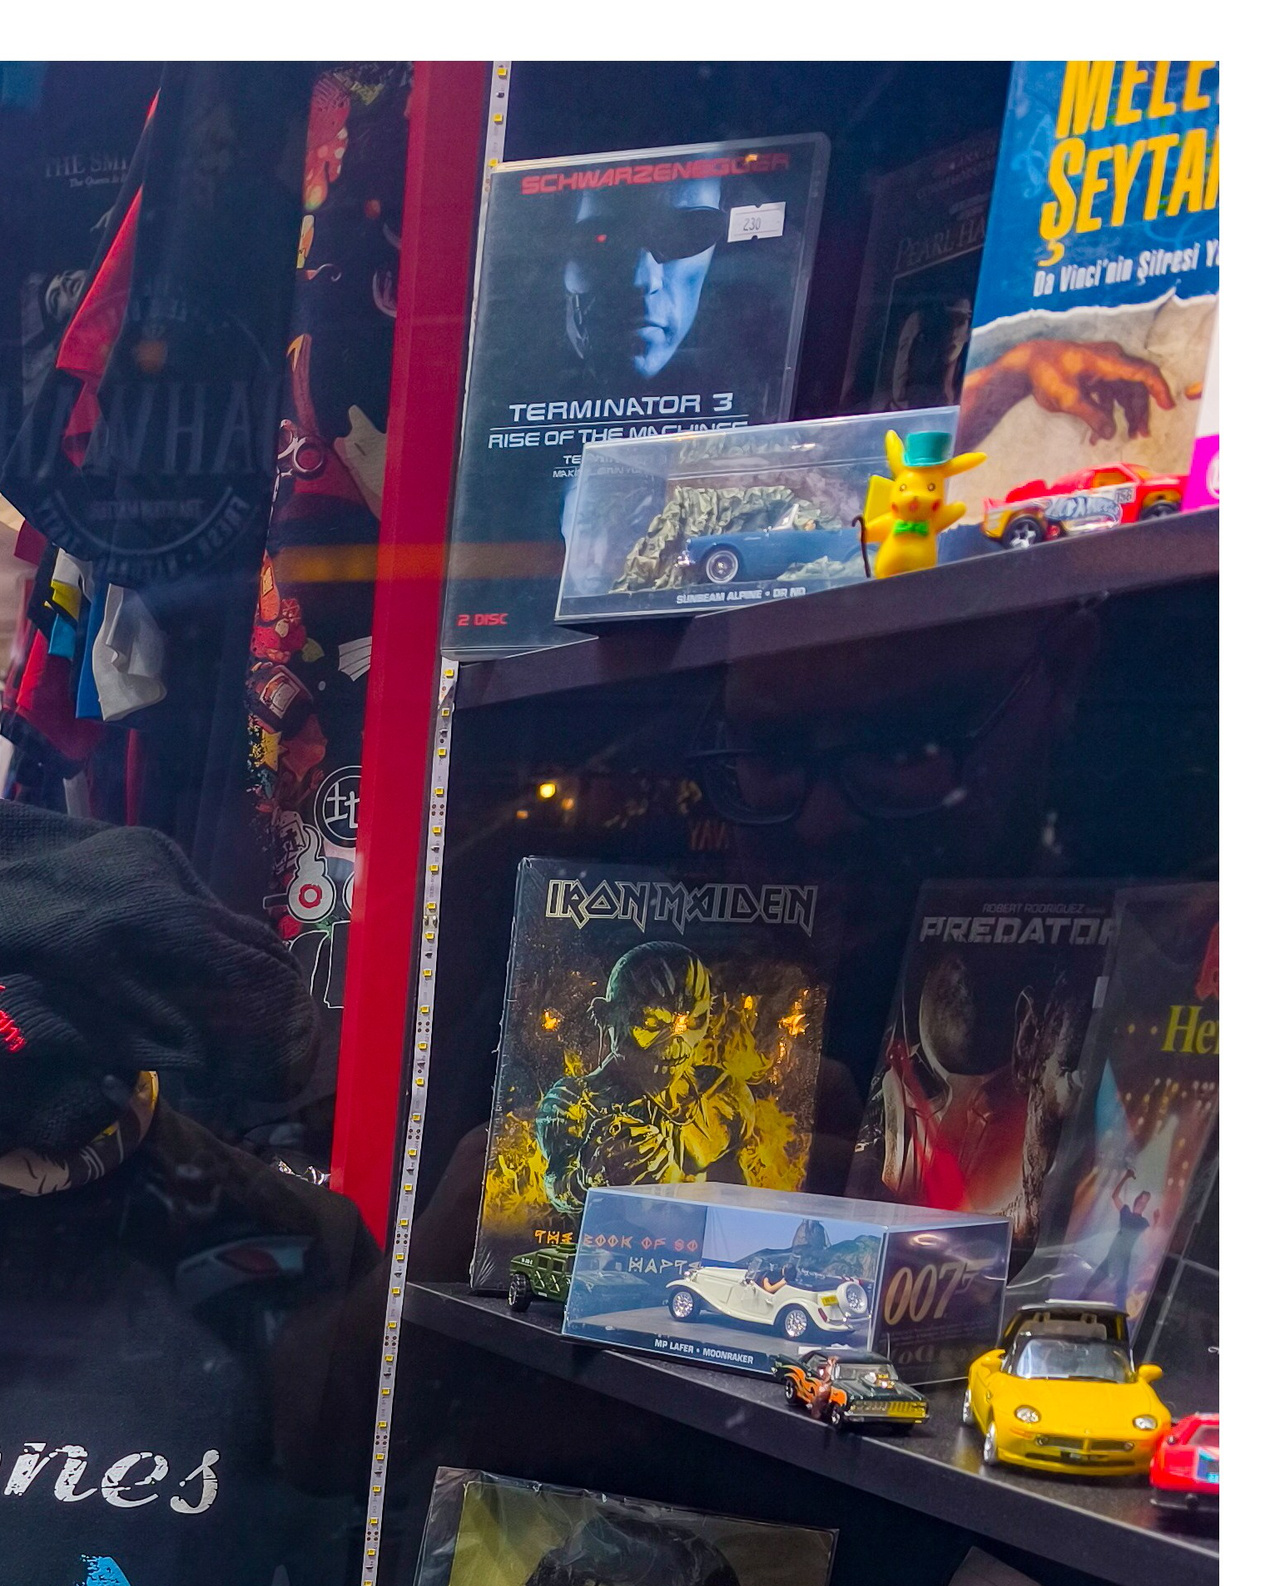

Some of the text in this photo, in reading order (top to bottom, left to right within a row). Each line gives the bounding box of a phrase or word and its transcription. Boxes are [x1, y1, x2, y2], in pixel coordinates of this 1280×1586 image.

[1055, 61, 1219, 139] MELE
[1033, 270, 1056, 297] Da
[509, 392, 734, 422] TERMINATOR 3
[488, 426, 624, 449] RISE OF THE
[676, 593, 725, 605] SUNBEAM
[727, 589, 762, 601] ALPINE
[457, 613, 508, 627] 2 DISC
[545, 879, 819, 938] IRON MAIDEN
[982, 902, 1022, 914] ROBERT
[1023, 902, 1086, 914] RODRIGUEZ
[534, 1229, 574, 1246] THE
[640, 1236, 666, 1251] OF
[883, 1261, 967, 1326] 007
[654, 1338, 754, 1365] MP LAFER MOONRAKER
